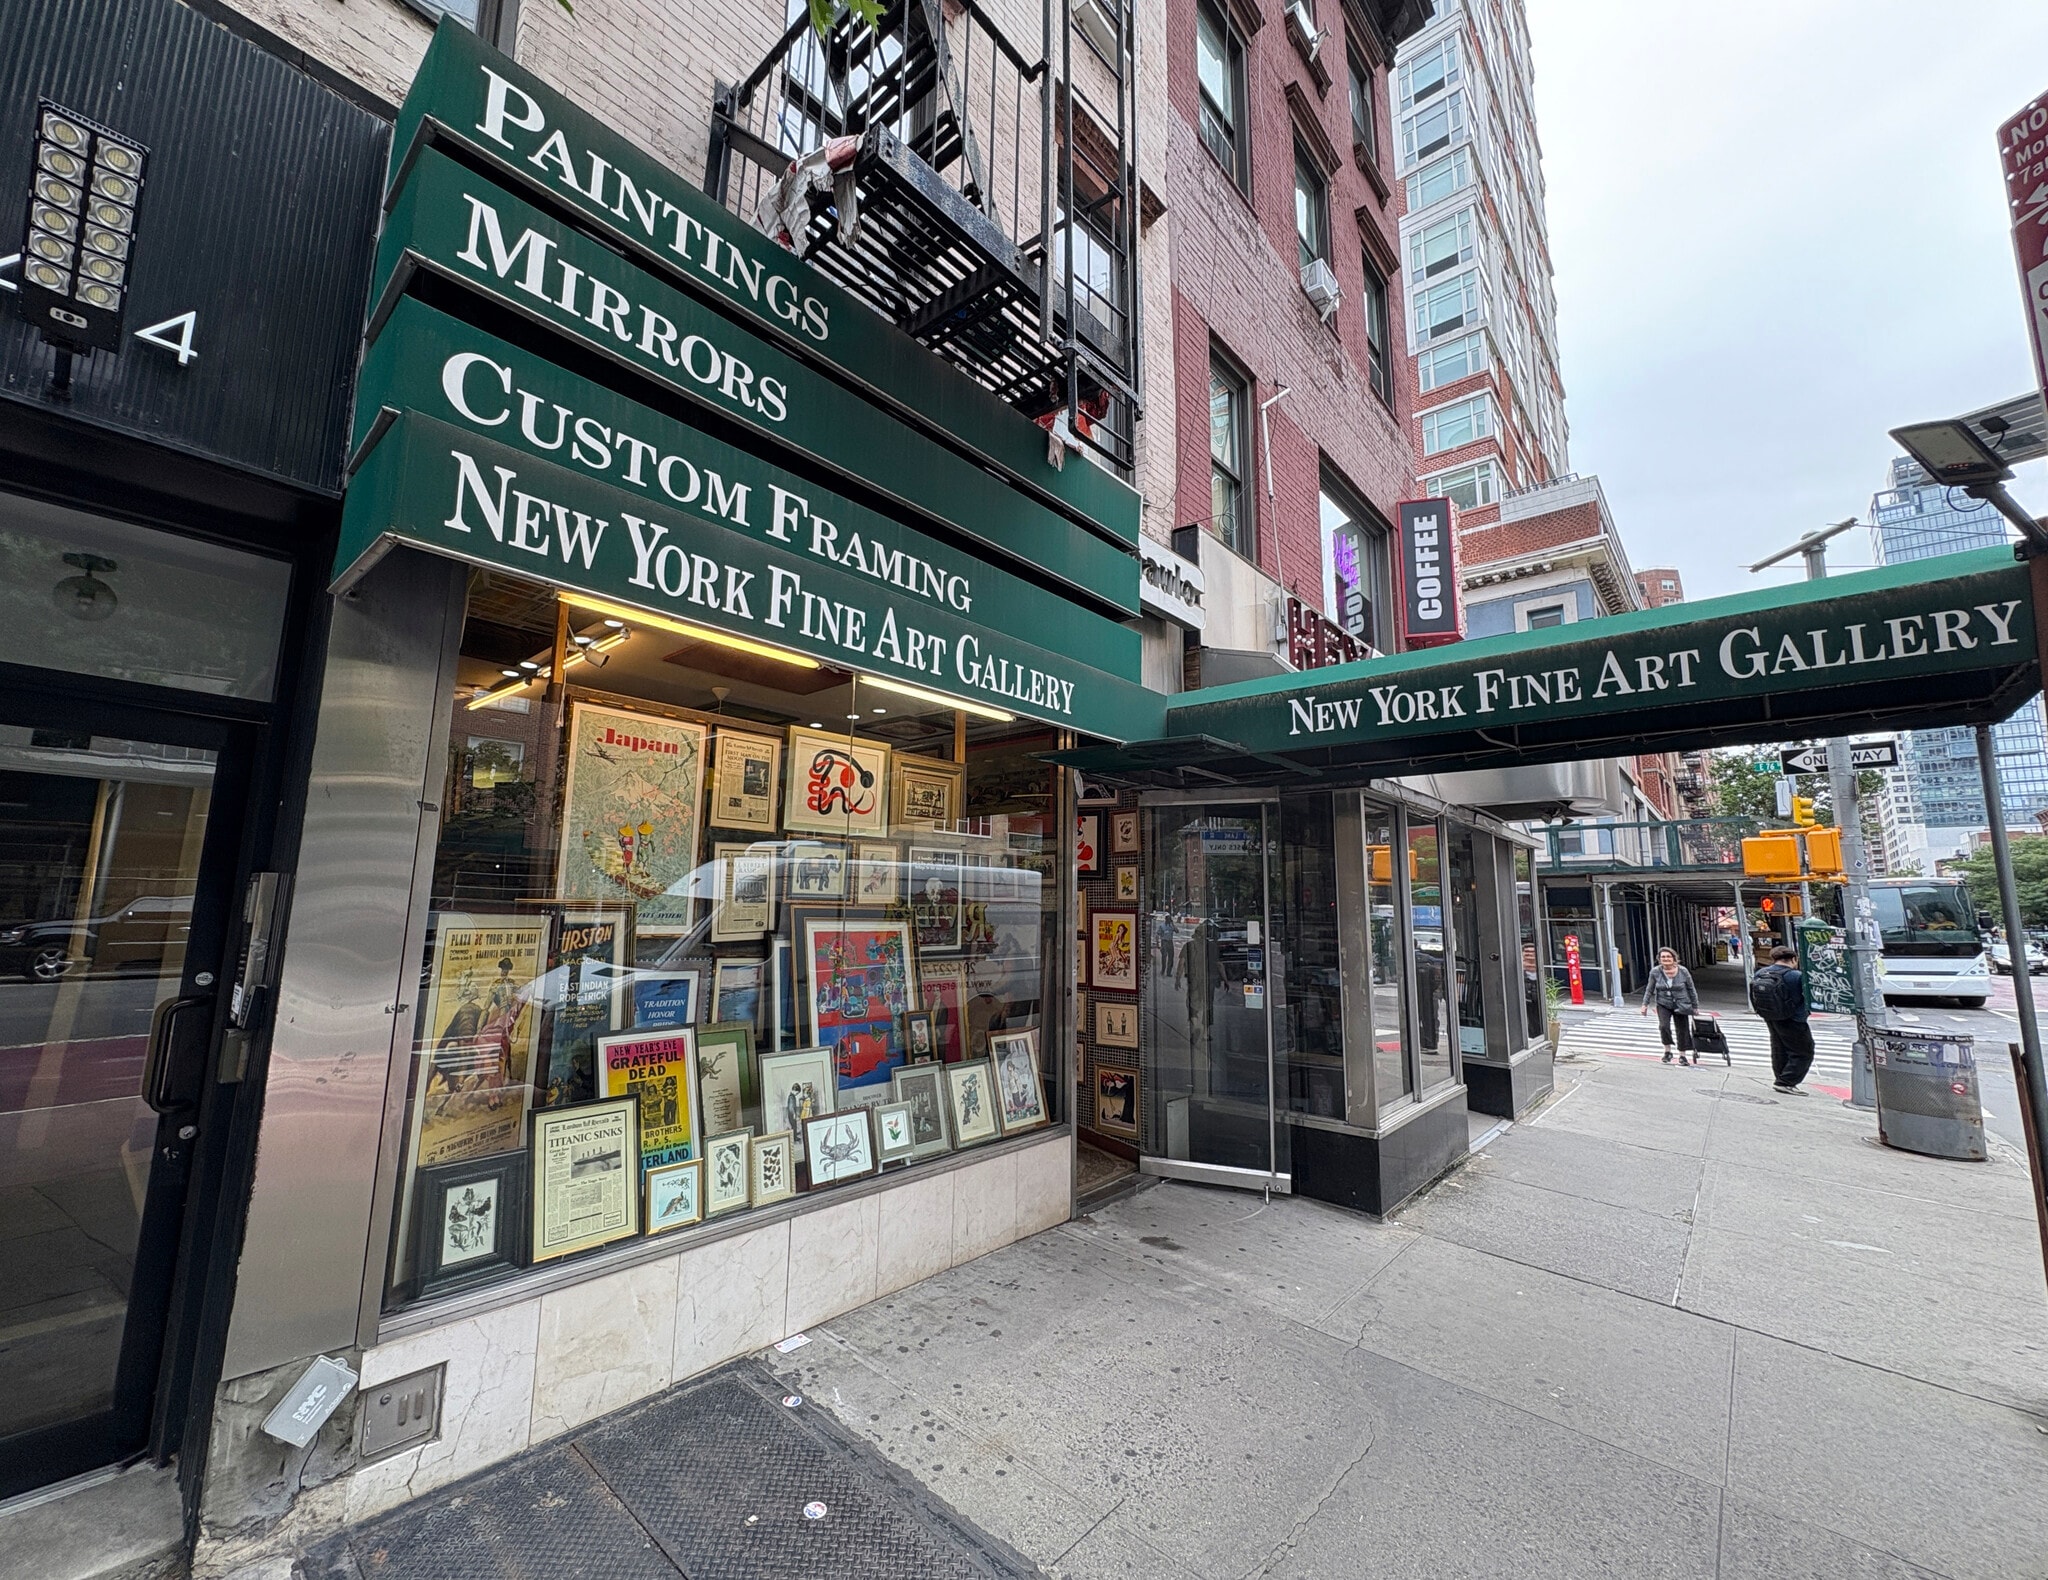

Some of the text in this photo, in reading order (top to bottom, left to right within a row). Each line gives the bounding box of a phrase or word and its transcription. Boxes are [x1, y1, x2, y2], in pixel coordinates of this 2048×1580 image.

[2011, 107, 2048, 146] NO
[2019, 155, 2048, 185] 7a
[475, 64, 829, 341] PAINTINGS
[456, 193, 788, 423] MIRRORS
[440, 351, 973, 613] CUSTOM FRAMING
[1413, 514, 1443, 621] COFFEE
[444, 450, 1076, 715] NEW YORK FINE ART GALLERY
[1288, 600, 2023, 735] NEW YORK FINE ART GALLERY
[596, 727, 679, 755] Japan
[1851, 749, 1883, 762] WAY
[451, 934, 471, 946] PLAZA
[560, 982, 579, 992] EAST
[644, 999, 685, 1009] TRADITION
[647, 1010, 676, 1019] HONOR
[614, 1040, 677, 1057] NEW YEAR'S EVE
[610, 1051, 682, 1070] GRATEFUL
[629, 1065, 667, 1081] DEAD
[548, 1126, 623, 1148] TITANIC SINKS
[645, 1124, 683, 1139] BROTHERS
